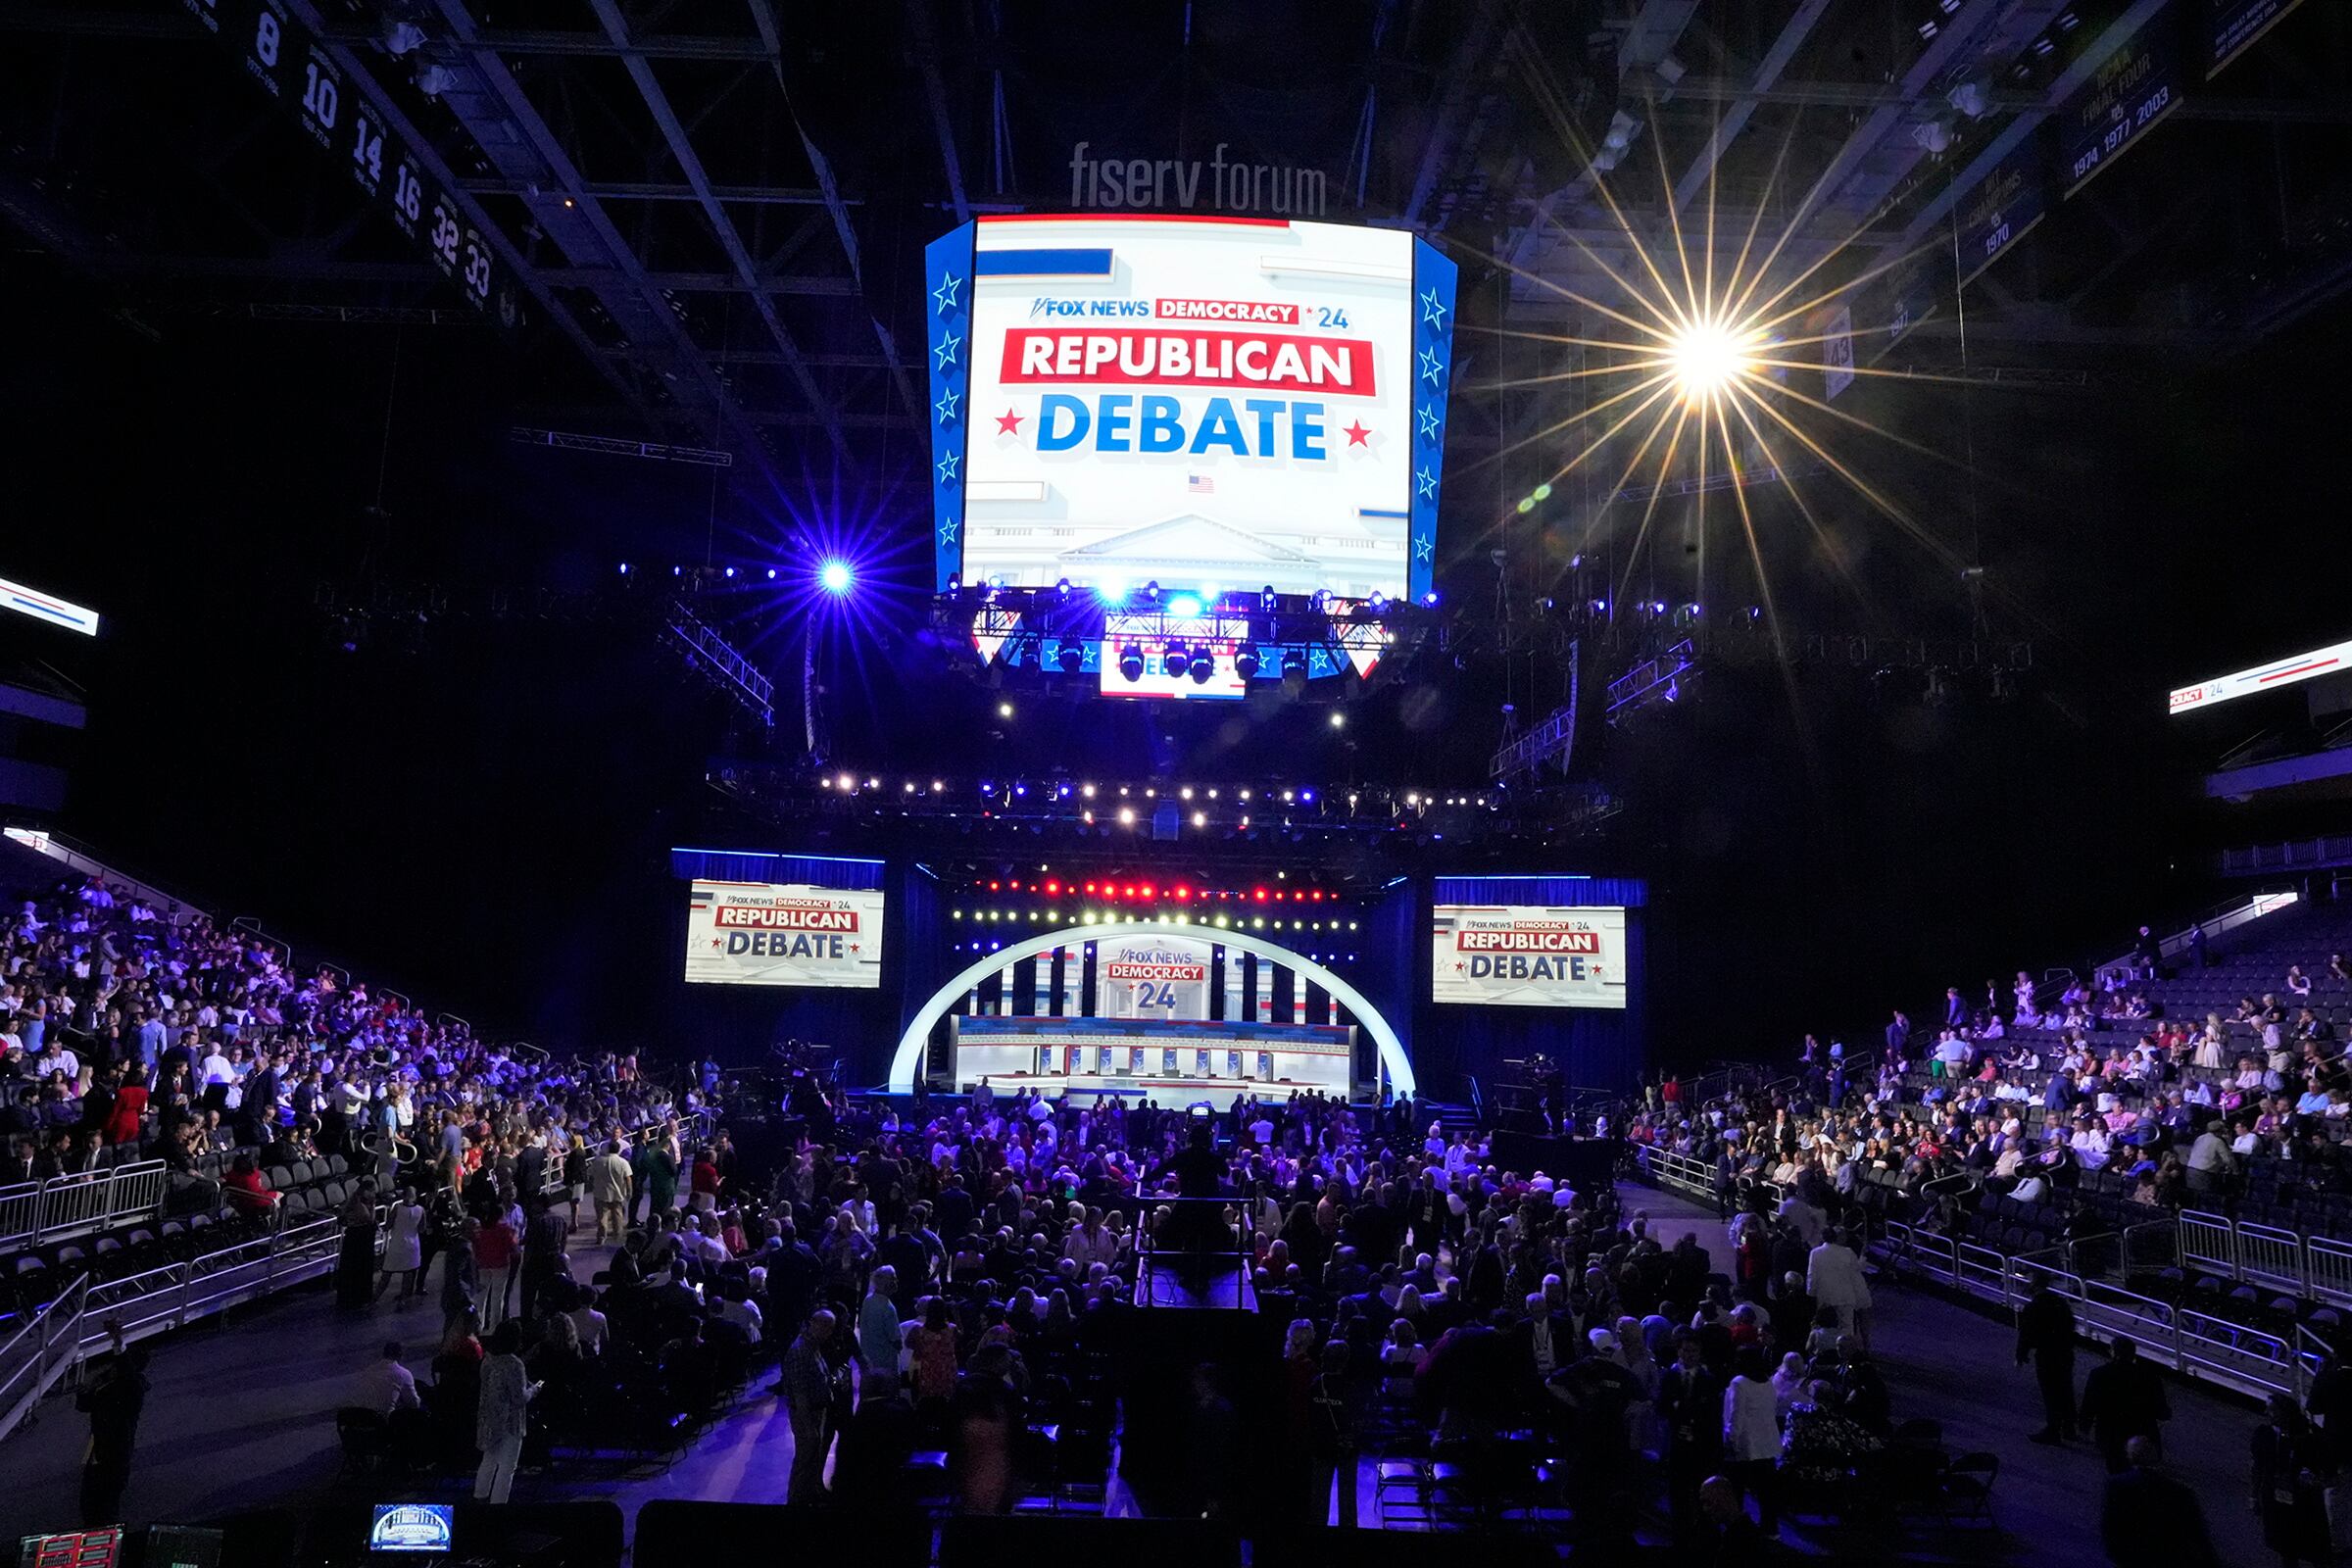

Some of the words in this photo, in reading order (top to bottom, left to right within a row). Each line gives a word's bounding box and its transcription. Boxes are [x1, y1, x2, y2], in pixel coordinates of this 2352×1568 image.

[257, 11, 281, 66] 8
[2118, 53, 2151, 95] FOUR
[302, 62, 338, 129] 10
[2074, 146, 2098, 178] 1974
[2103, 118, 2131, 153] 1977
[2135, 85, 2169, 125] 2003
[353, 117, 383, 184] 14
[394, 164, 421, 222] 16
[1069, 141, 1200, 208] fiserv
[1209, 143, 1327, 216] forum
[430, 205, 461, 266] 32
[1985, 222, 2009, 256] 1970
[465, 244, 491, 298] 33
[1046, 298, 1085, 318] FOX
[1091, 300, 1150, 318] NEWS
[1160, 299, 1295, 323] DEMOCRACY
[1020, 335, 1352, 387] REPUBLICAN
[1036, 394, 1327, 461] DEBATE
[2210, 683, 2223, 697] 24
[721, 908, 852, 929] REPUBLICAN
[777, 898, 830, 908] DEMOCRACY
[1462, 933, 1592, 952] REPUBLICAN
[1515, 921, 1568, 930] DEMOCRACY
[727, 931, 844, 958] DEBATE
[1128, 950, 1152, 964] FOX
[1155, 951, 1193, 964] NEWS
[1111, 964, 1201, 980] DEMOCRACY
[1470, 956, 1586, 981] DEBATE
[1138, 981, 1177, 1009] 24
